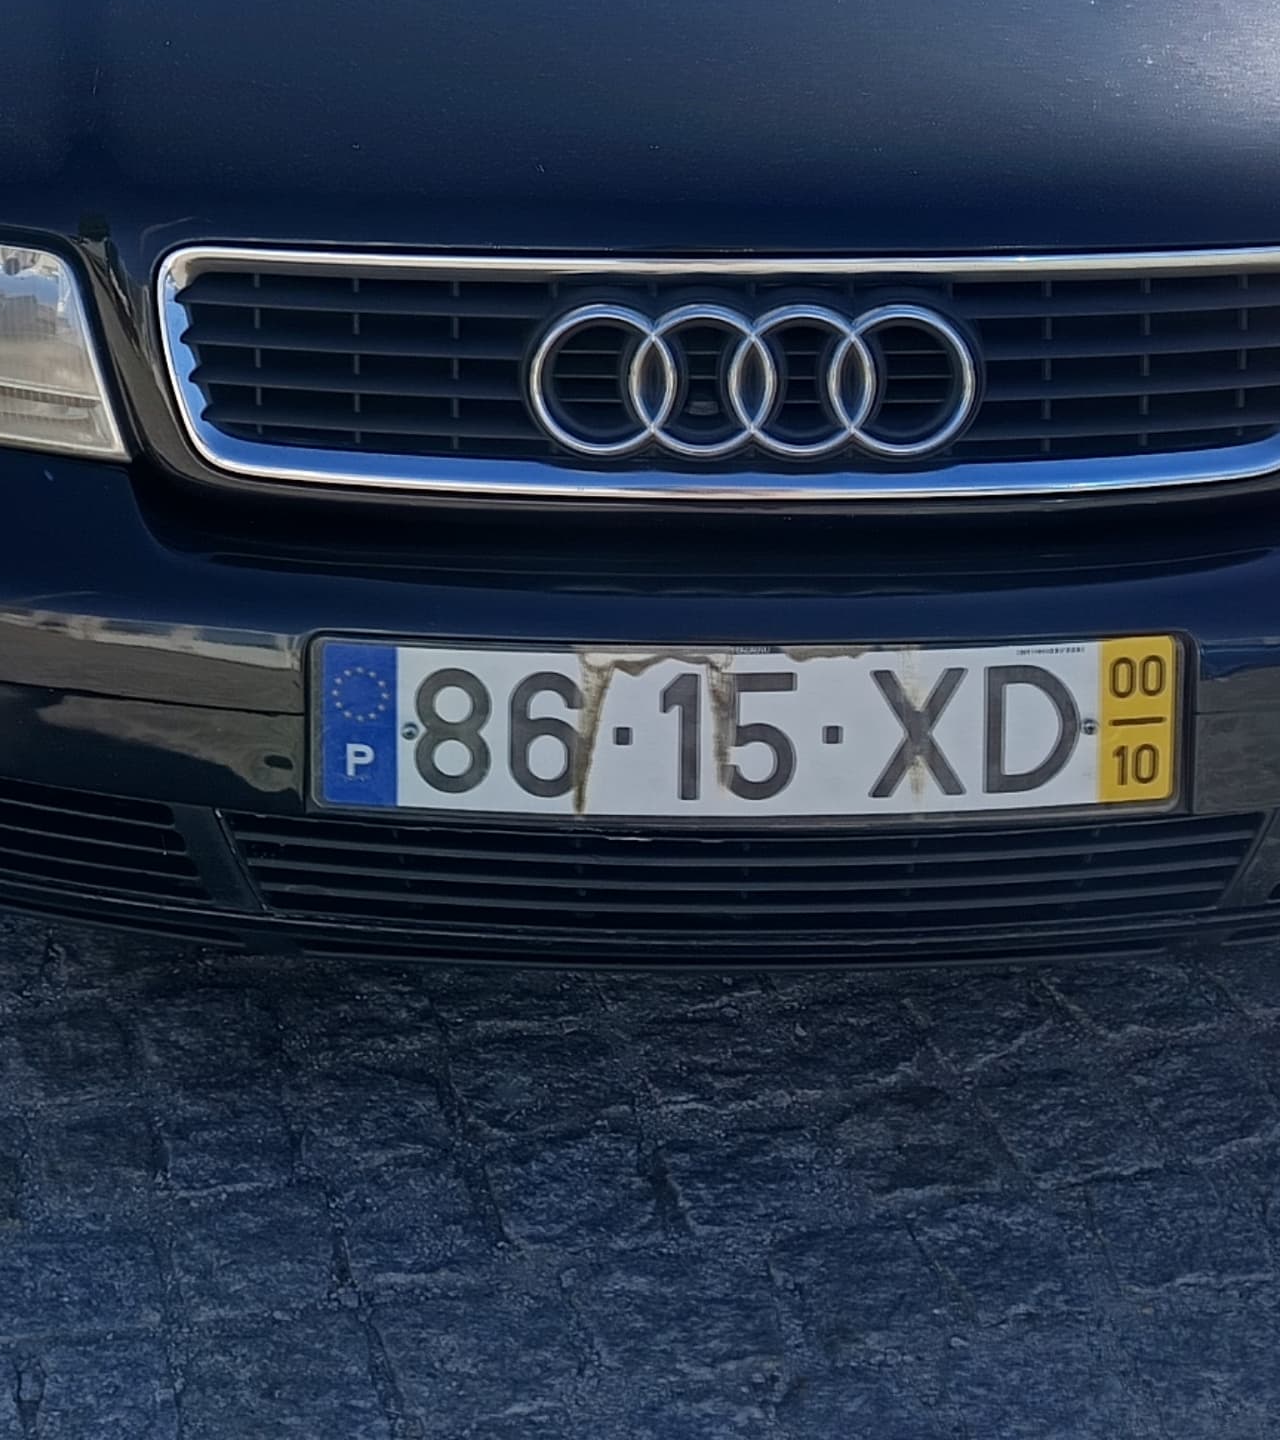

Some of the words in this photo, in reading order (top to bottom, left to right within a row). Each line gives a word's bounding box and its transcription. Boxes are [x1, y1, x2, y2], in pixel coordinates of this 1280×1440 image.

[1109, 654, 1167, 699] 00
[345, 742, 376, 777] P
[1112, 743, 1160, 786] 10
